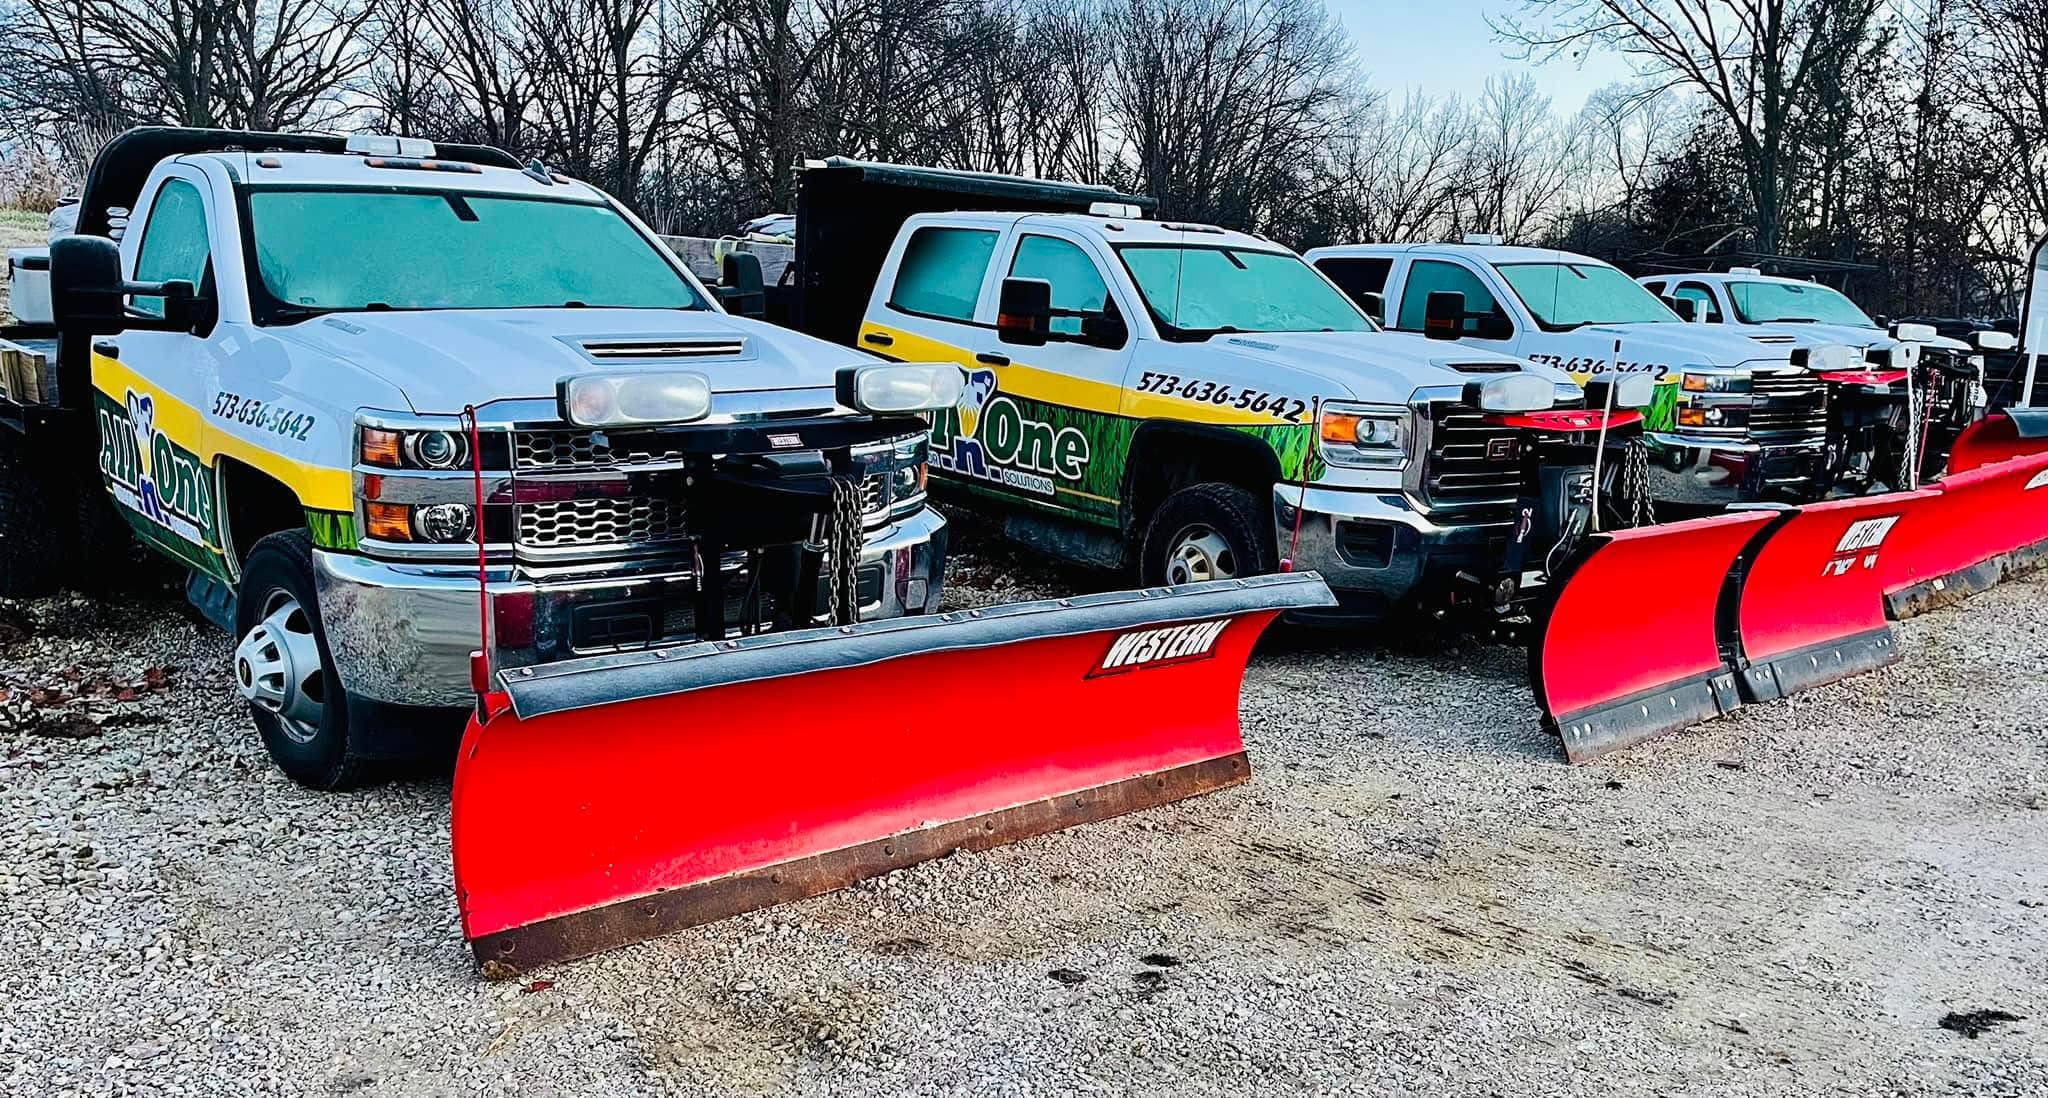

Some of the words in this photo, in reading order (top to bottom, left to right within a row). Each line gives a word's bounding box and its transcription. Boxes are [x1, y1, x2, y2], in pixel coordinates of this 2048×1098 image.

[212, 391, 316, 442] 573-636-5642
[1136, 371, 1306, 423] 573-636-5642
[983, 396, 1090, 480] One
[100, 408, 138, 491] All
[152, 427, 211, 530] One
[1003, 470, 1055, 496] SOLUTIONS
[1101, 618, 1233, 669] WESTERN
